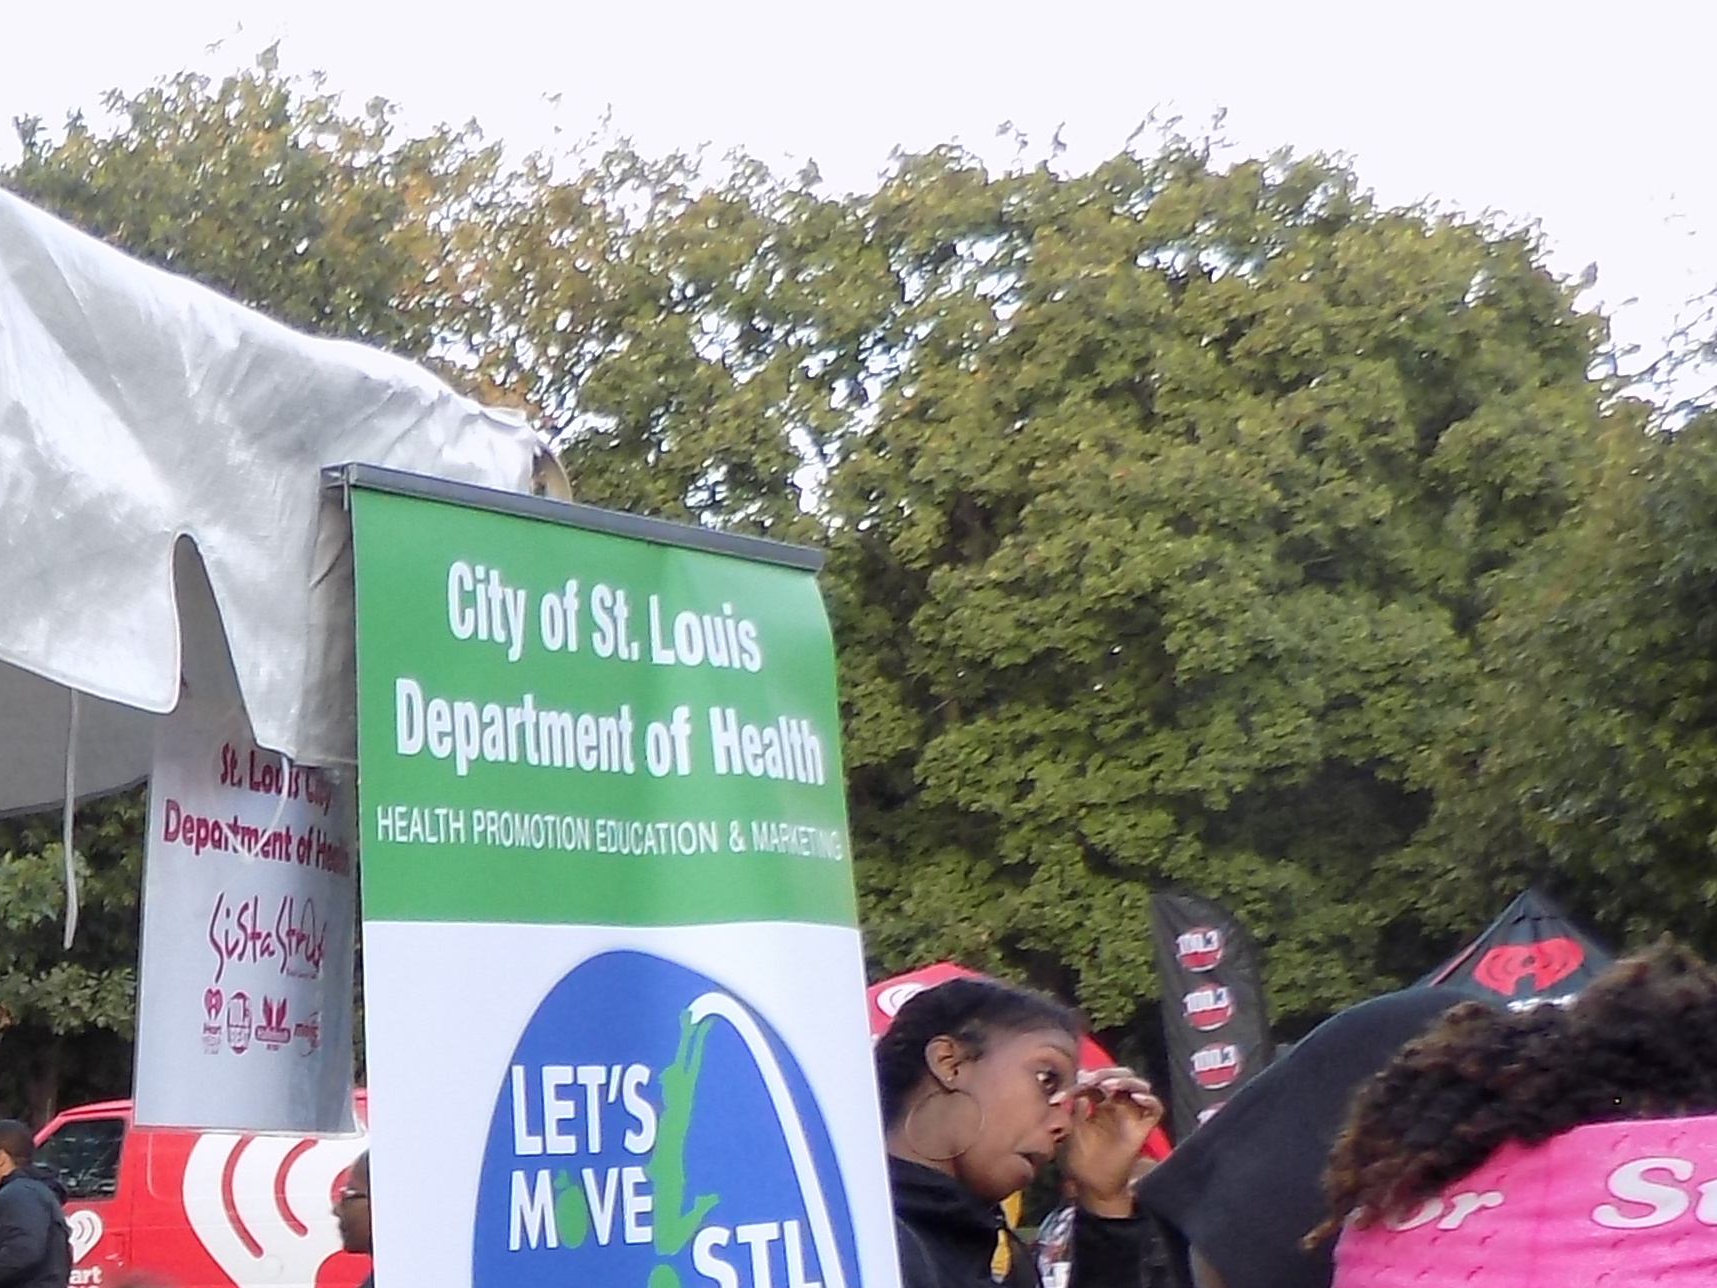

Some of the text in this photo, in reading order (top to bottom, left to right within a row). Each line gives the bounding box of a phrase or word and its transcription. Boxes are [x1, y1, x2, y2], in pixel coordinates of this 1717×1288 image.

[446, 560, 763, 674] City of St. Louis
[395, 677, 826, 786] Department of Health
[377, 805, 843, 861] HEALTH PROMOTION EDUCATION & MARKETING
[511, 1062, 658, 1156] LET'S
